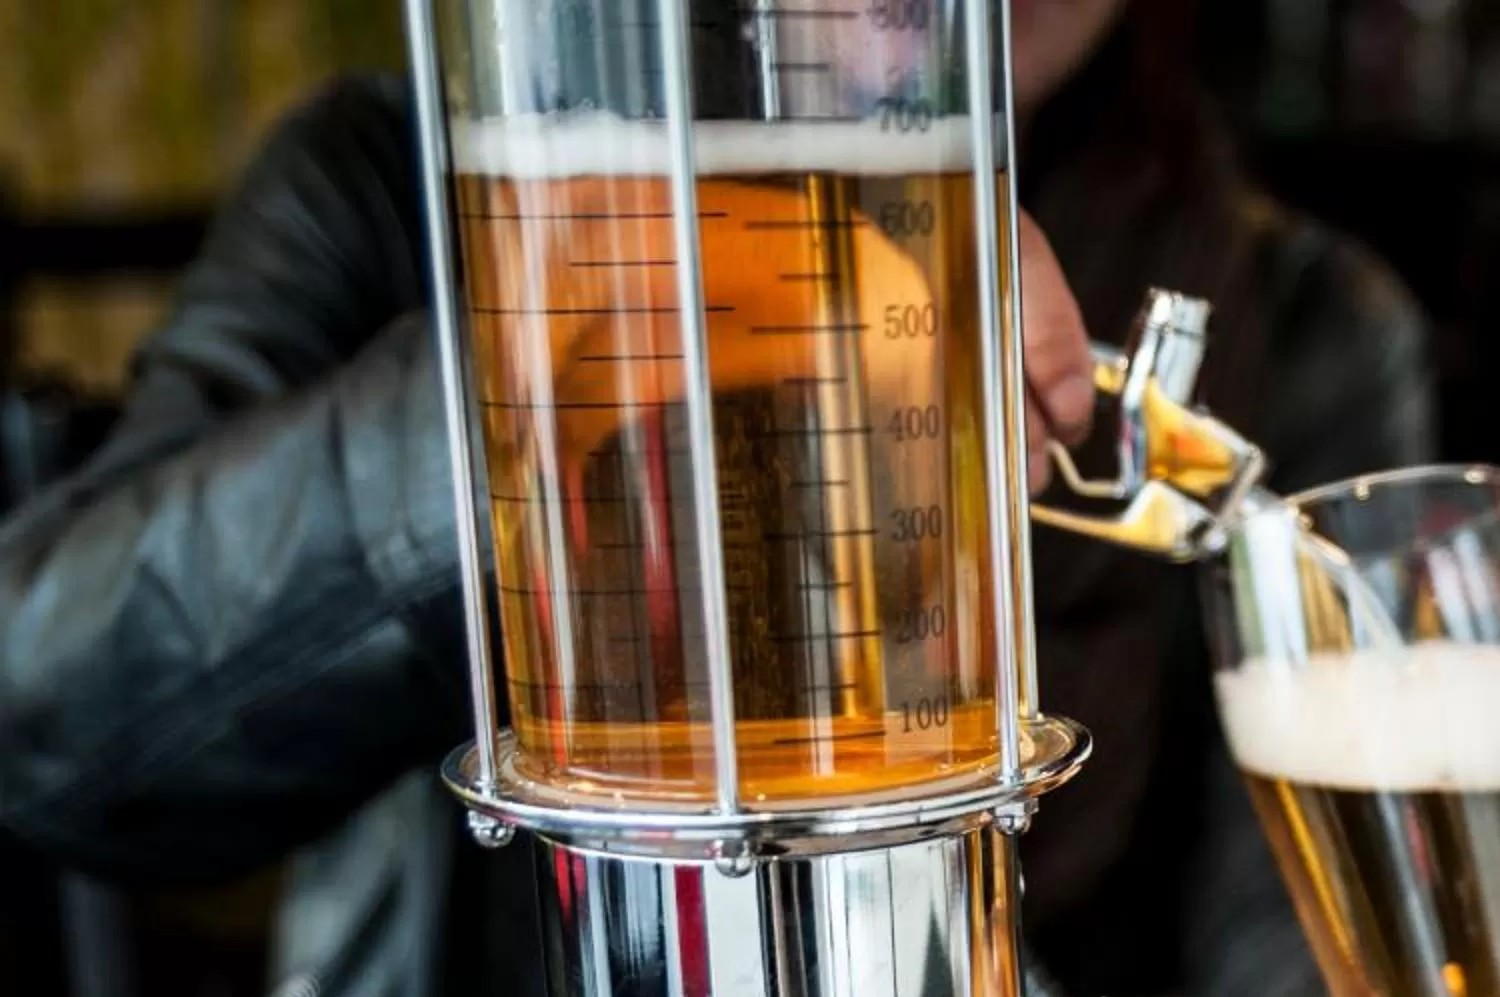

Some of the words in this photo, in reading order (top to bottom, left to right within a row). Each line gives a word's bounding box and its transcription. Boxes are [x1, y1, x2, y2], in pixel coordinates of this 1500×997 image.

[876, 96, 931, 133] 700
[881, 202, 934, 238] 600
[884, 303, 937, 339] 500
[887, 405, 940, 441] 400
[890, 504, 942, 542] 300
[894, 604, 945, 644] 200
[901, 695, 948, 733] 100
